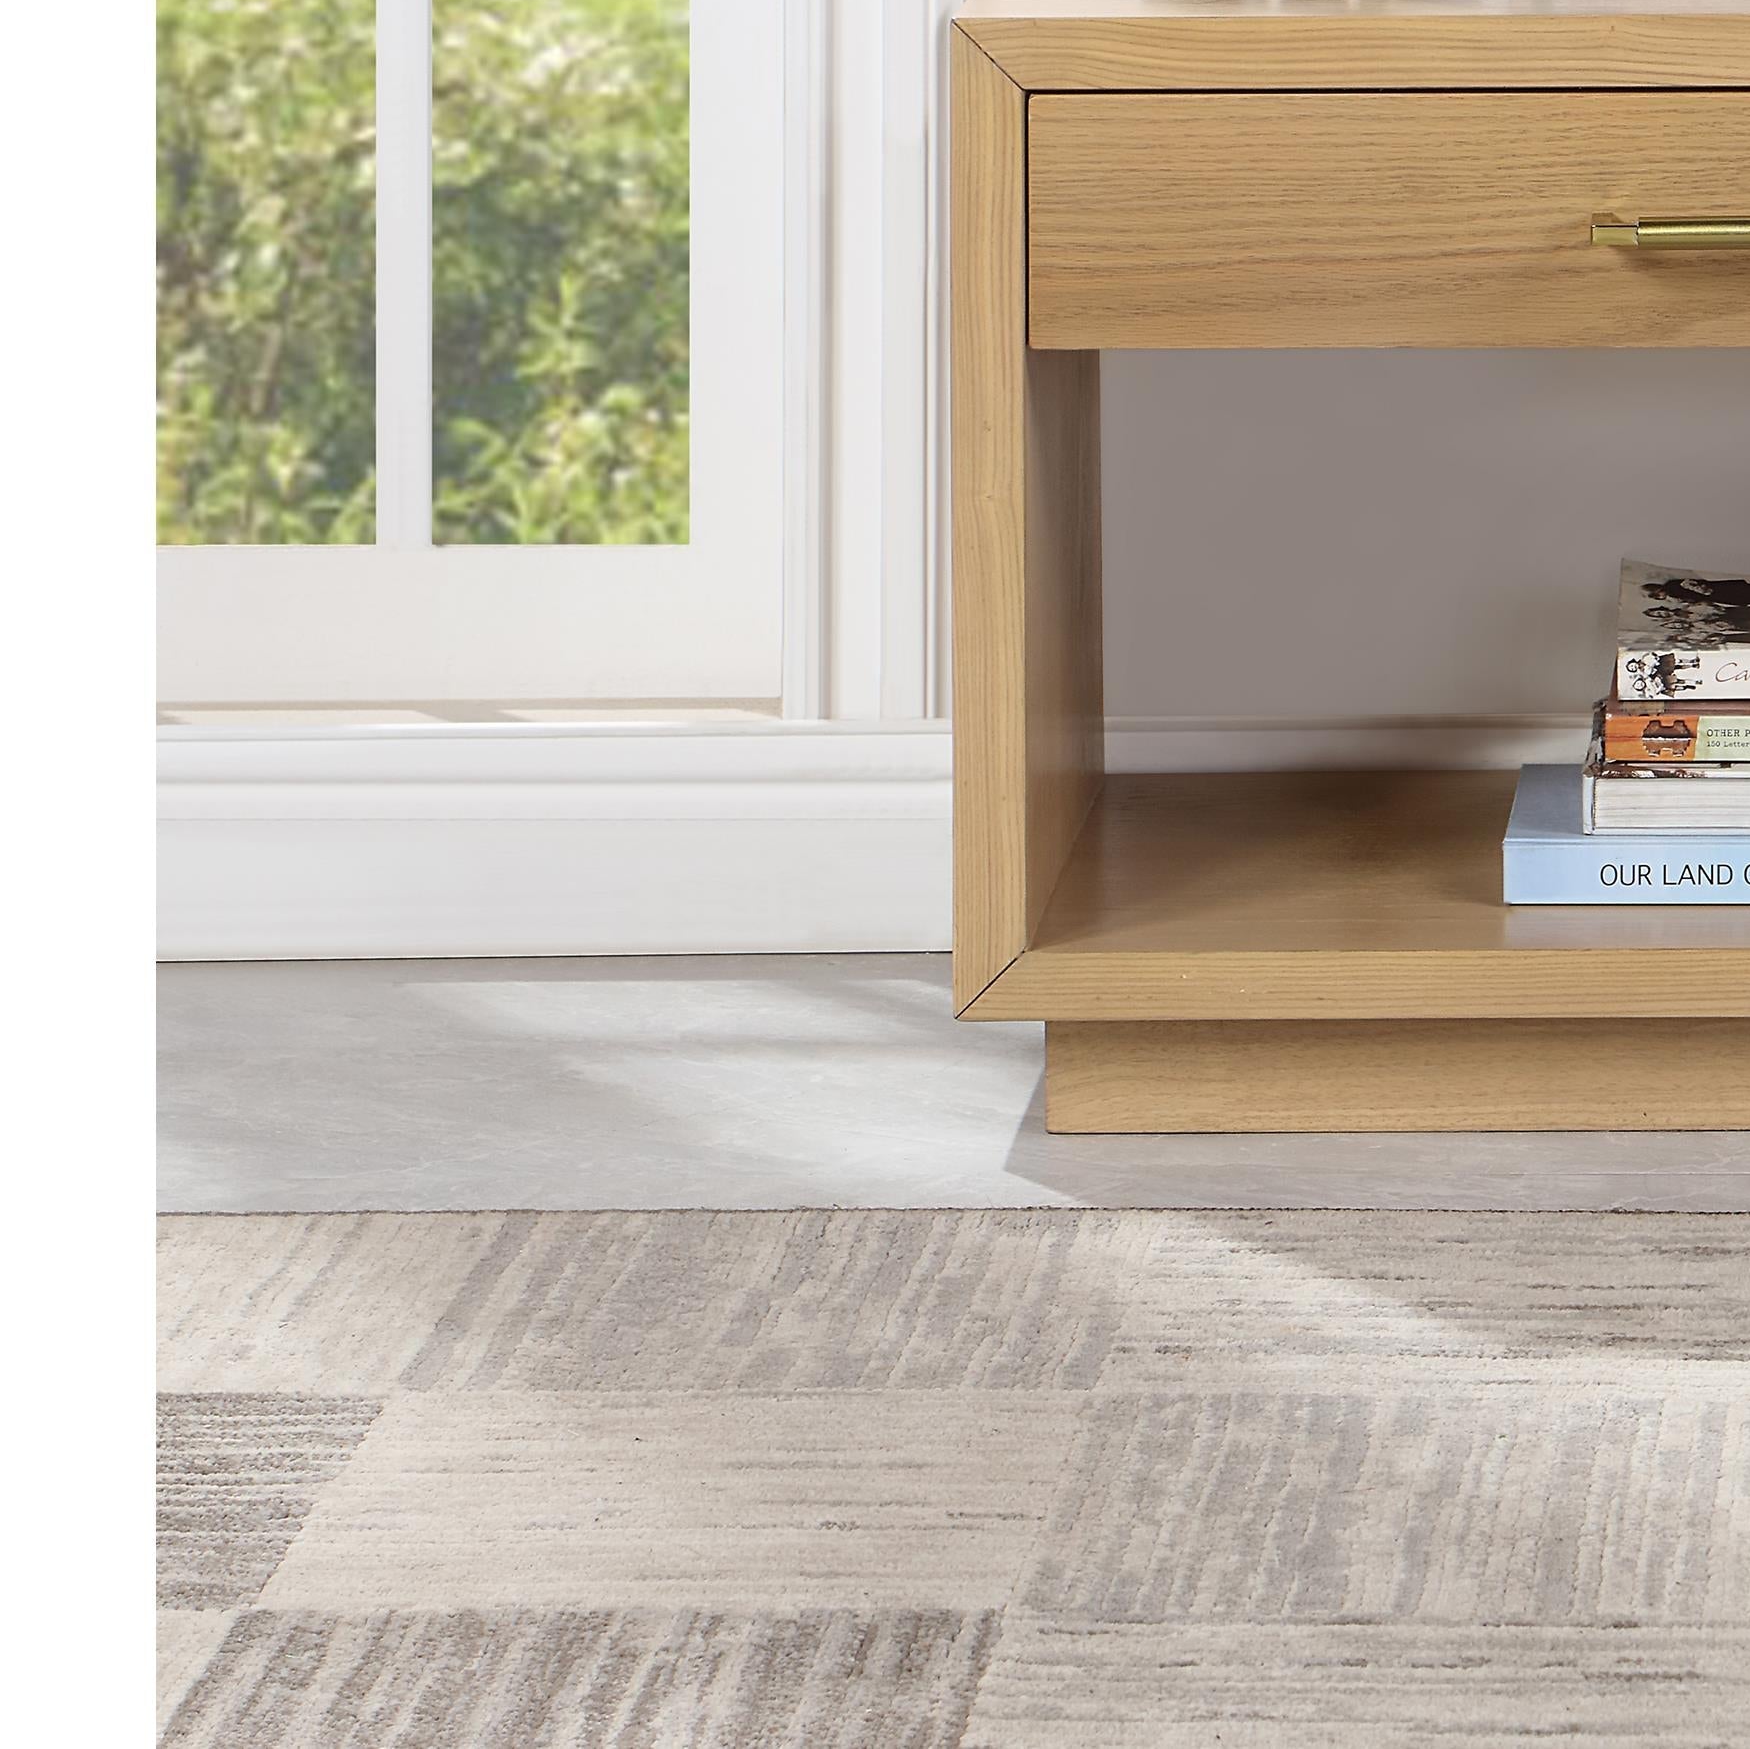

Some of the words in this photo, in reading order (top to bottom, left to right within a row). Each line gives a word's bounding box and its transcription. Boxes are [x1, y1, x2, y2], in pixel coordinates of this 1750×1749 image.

[1707, 729, 1740, 737] OTHER
[1600, 863, 1651, 886] OUR
[1662, 863, 1733, 886] LAND
